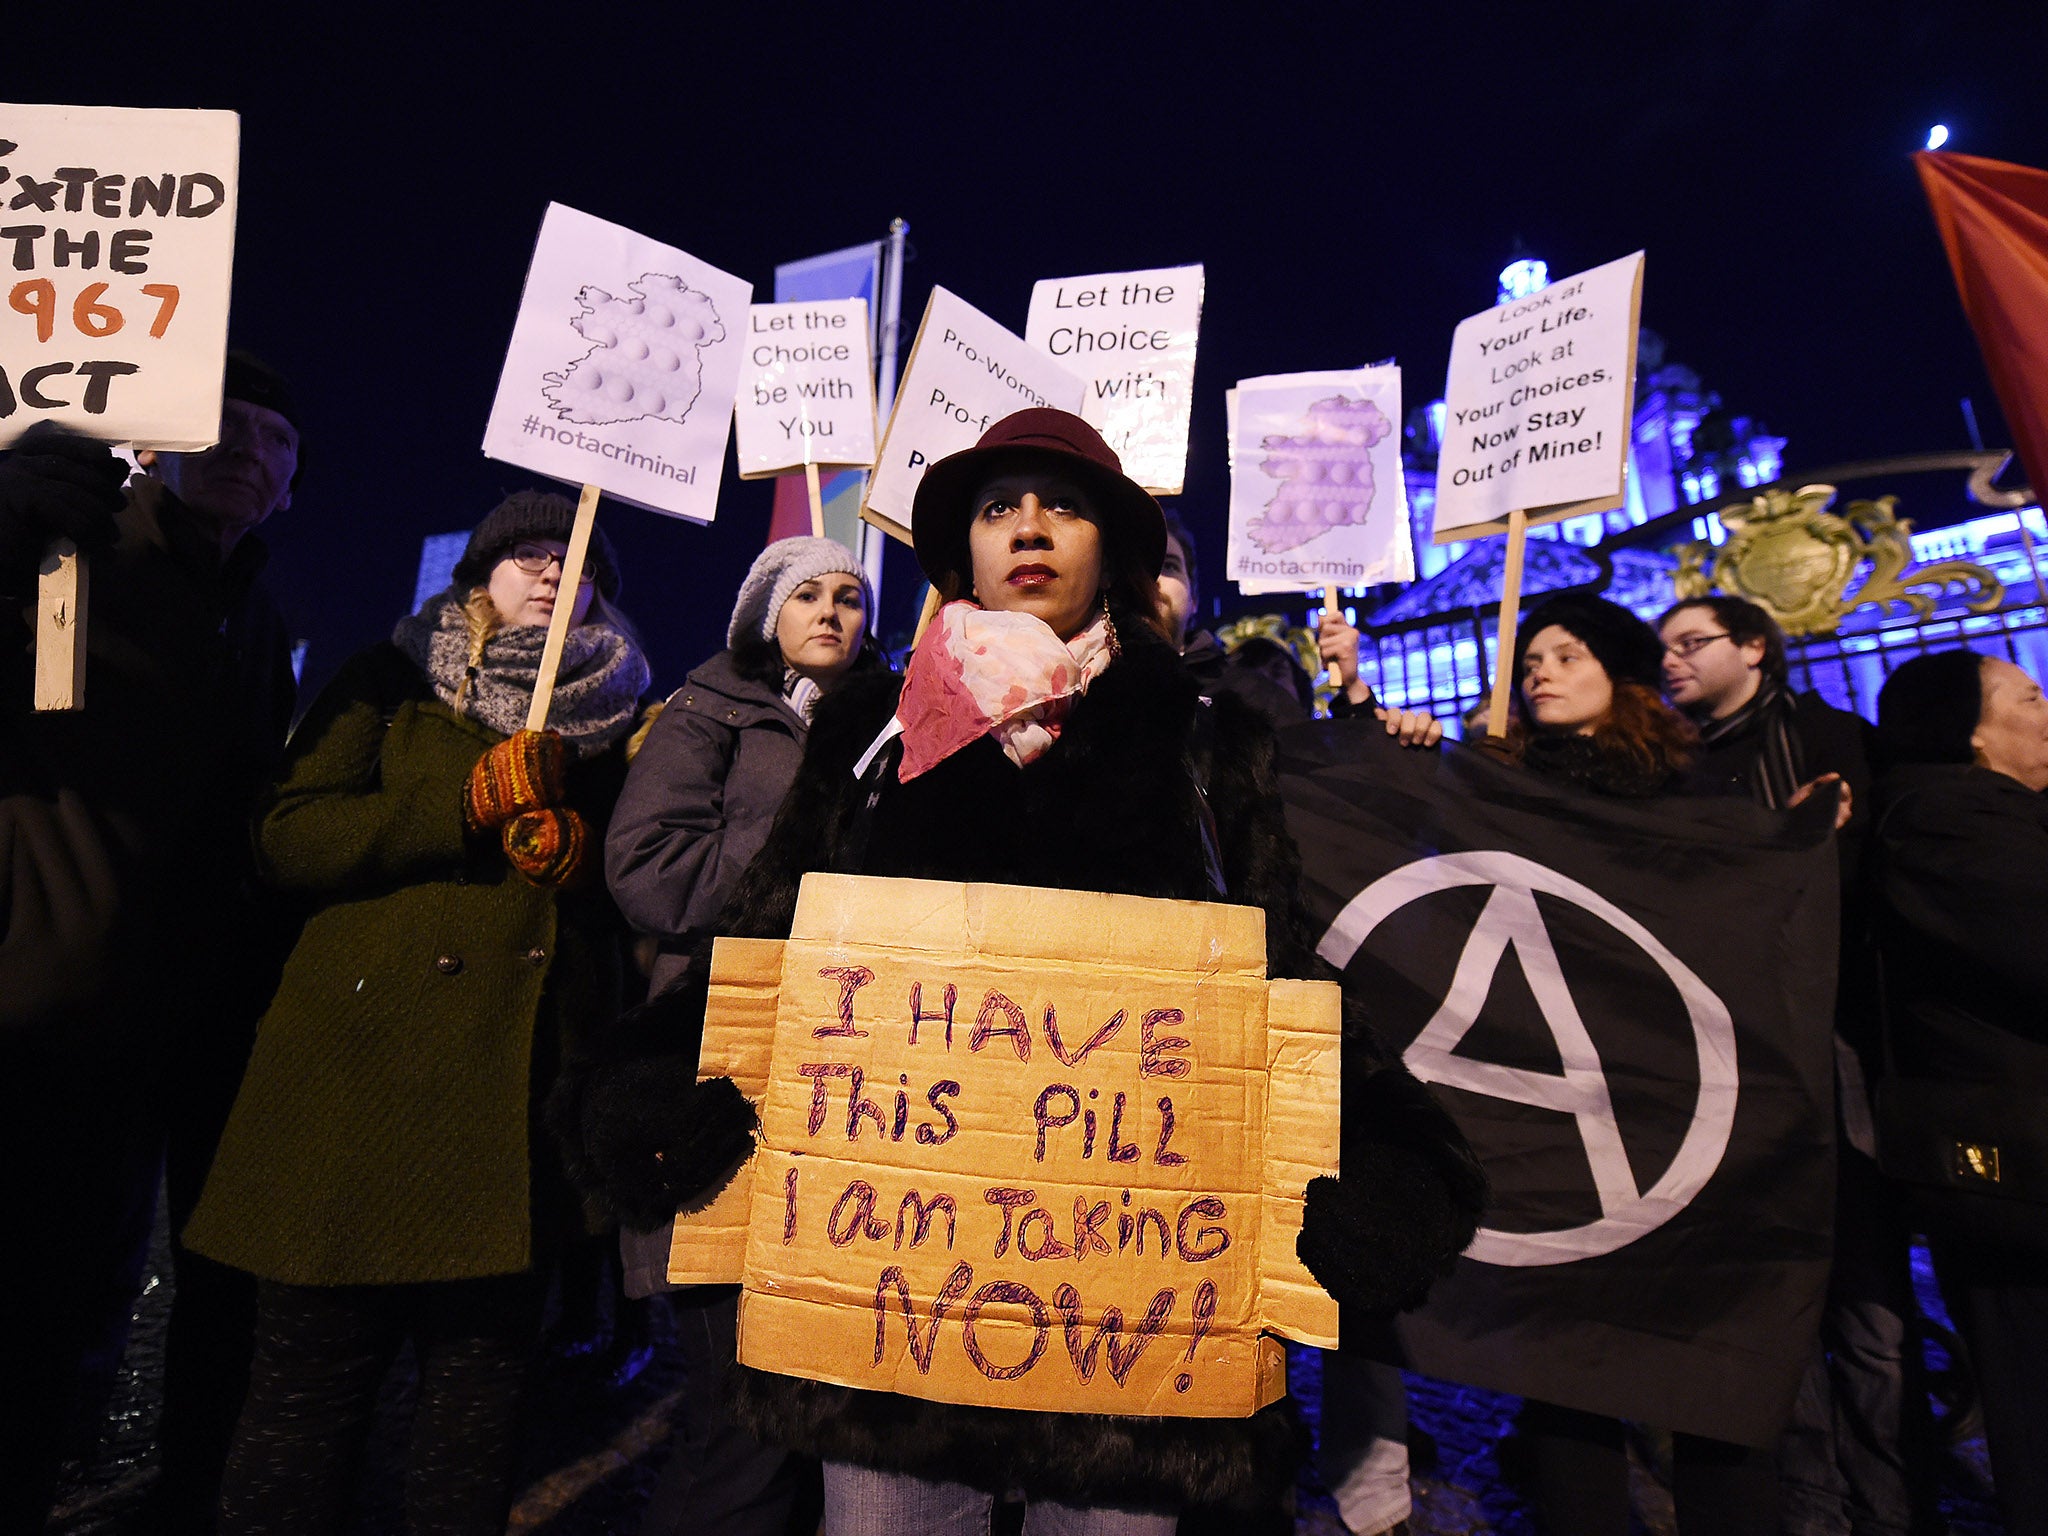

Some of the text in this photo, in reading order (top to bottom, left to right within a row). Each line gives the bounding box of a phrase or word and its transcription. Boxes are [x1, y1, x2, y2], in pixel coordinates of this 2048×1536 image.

[0, 224, 154, 276] THE
[1055, 281, 1175, 309] Let the
[1499, 281, 1585, 324] Look at
[753, 311, 847, 333] Let the
[1048, 324, 1171, 356] Choice
[1479, 325, 1534, 358] Your
[753, 342, 850, 367] Choice
[1491, 338, 1575, 385] Look at
[754, 377, 854, 406] be with
[1094, 371, 1166, 400] with
[778, 416, 834, 440] You
[929, 388, 993, 432] Pro-f
[1455, 400, 1505, 427] Your
[1471, 406, 1586, 453] Now Stay
[522, 414, 697, 486] #notacriminal
[1452, 430, 1603, 487] Out of Mine!
[811, 965, 1192, 1081] I HAVE
[783, 1150, 805, 1247] I
[869, 1260, 1220, 1395] NOW!
